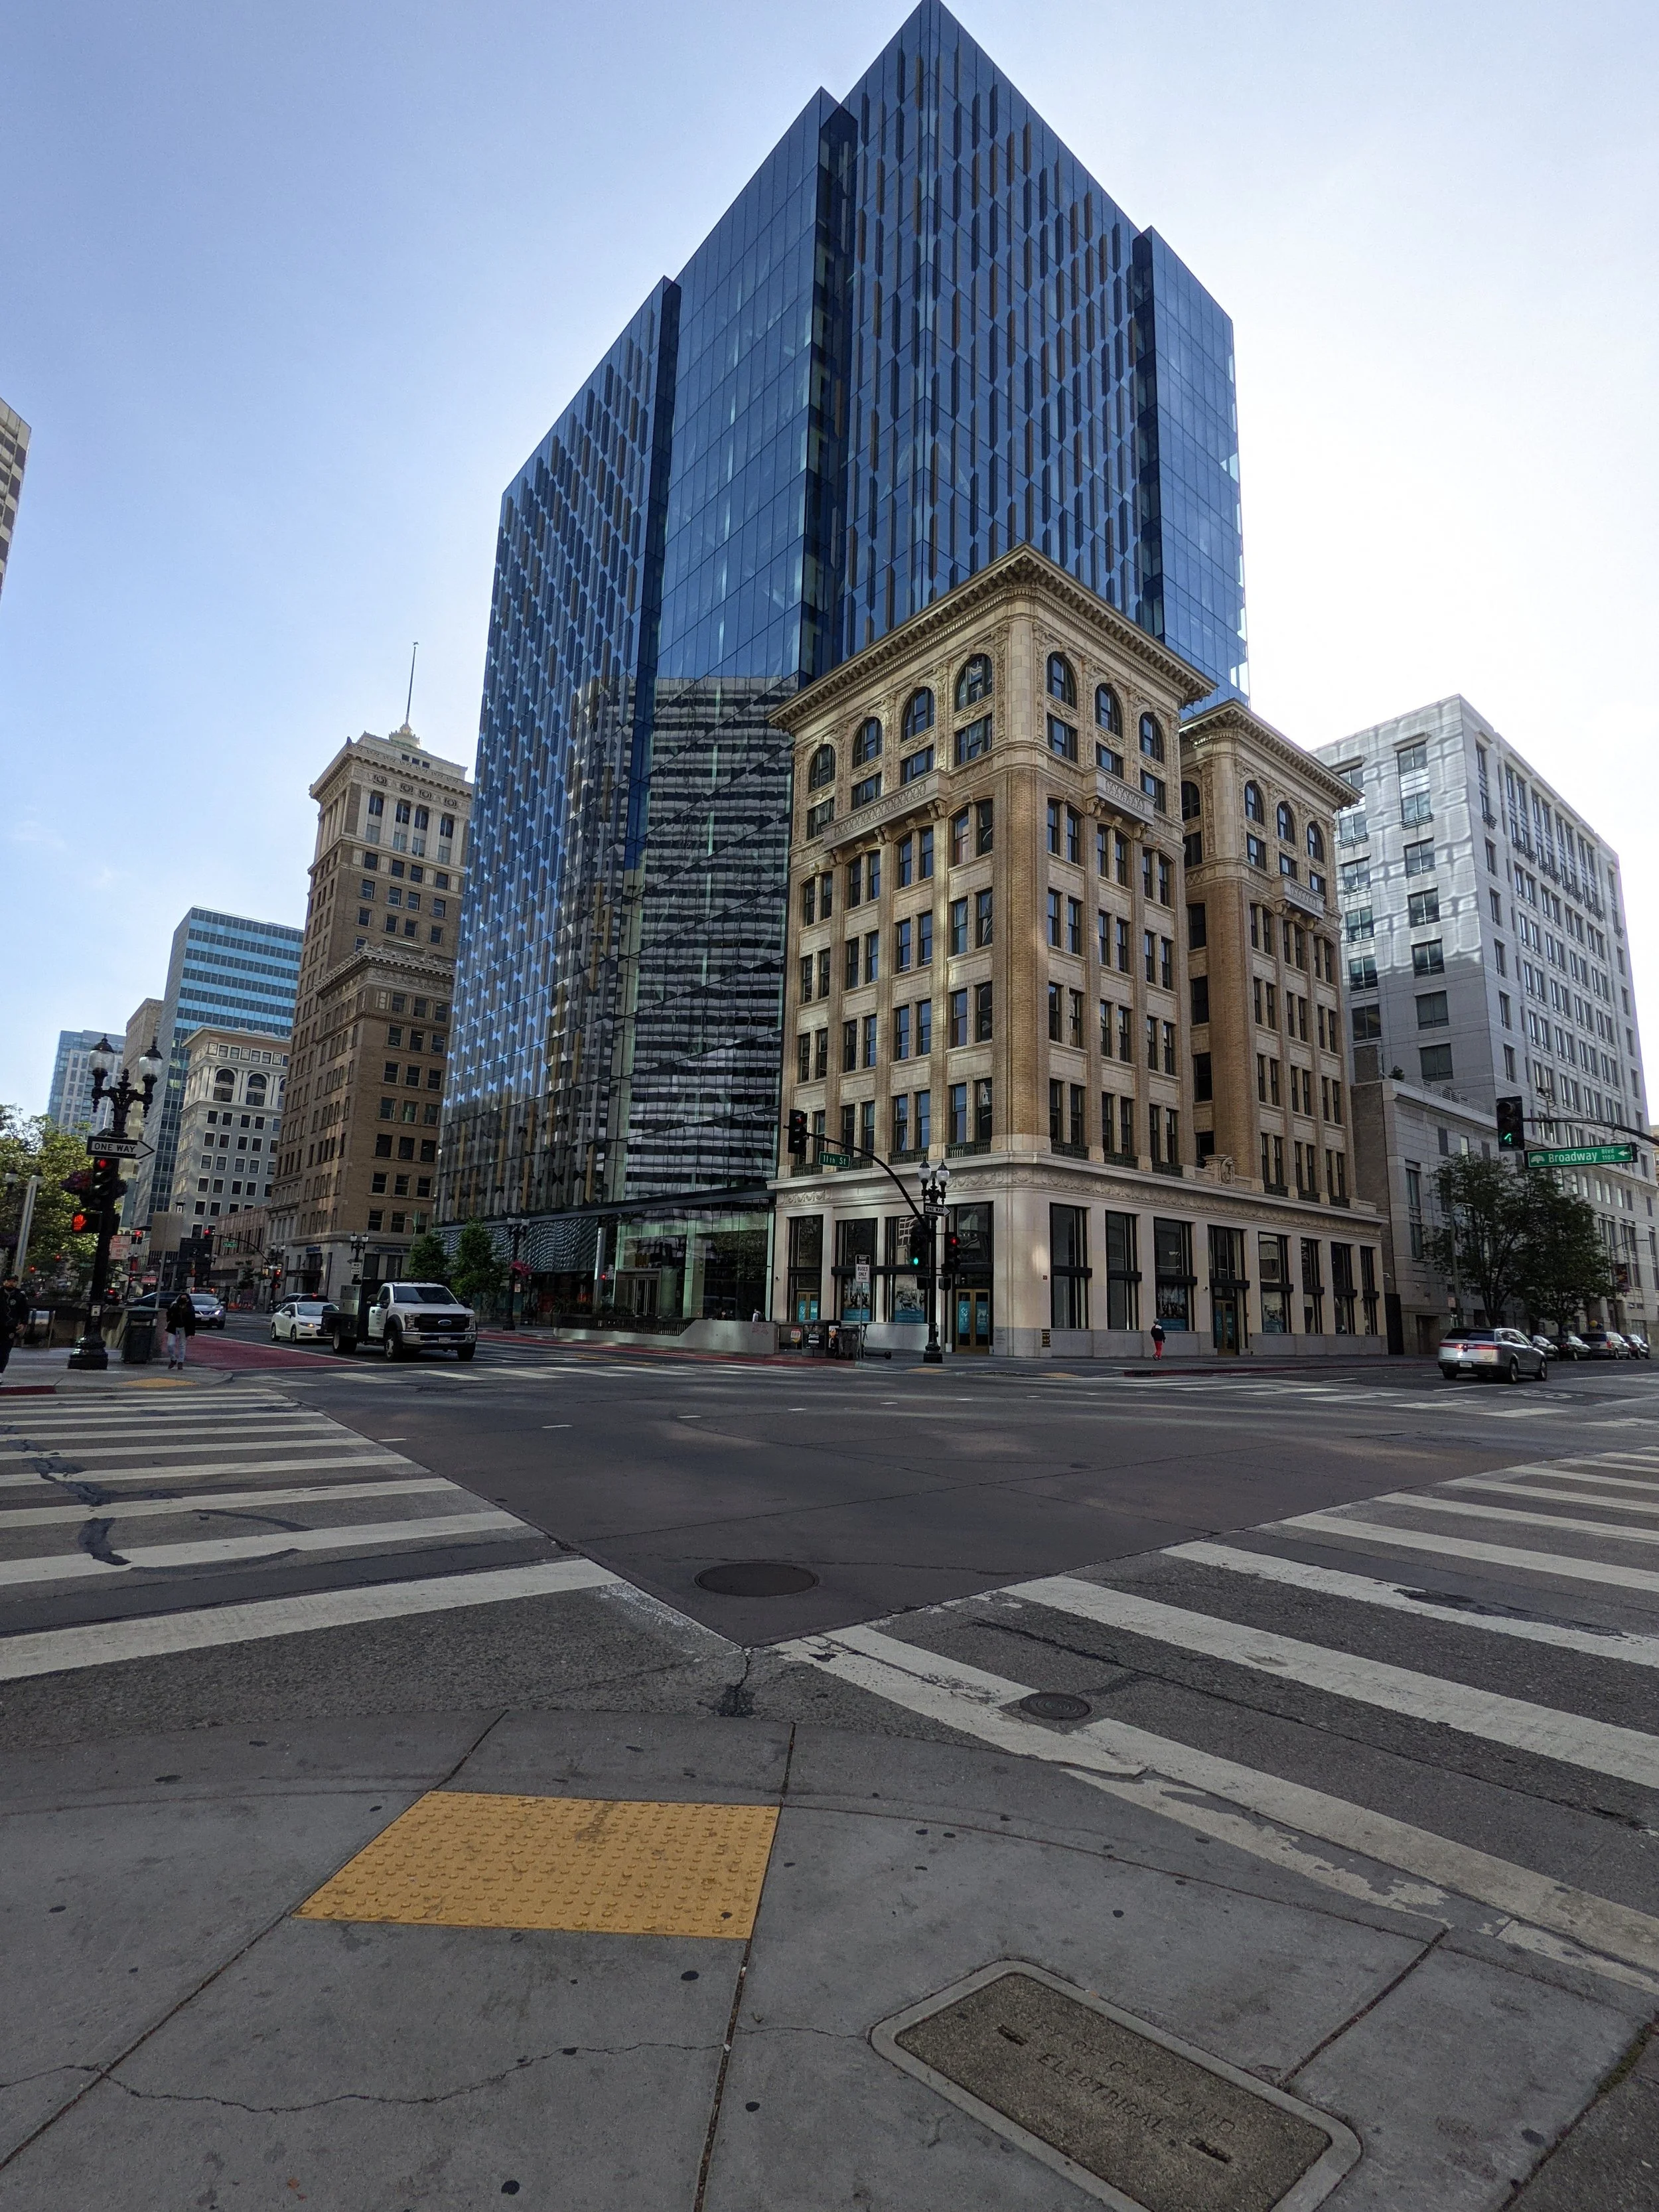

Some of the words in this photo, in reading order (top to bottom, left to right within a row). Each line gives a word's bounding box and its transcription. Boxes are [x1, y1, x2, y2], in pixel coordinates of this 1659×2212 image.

[823, 1155, 835, 1163] 11th
[839, 1157, 846, 1165] St
[1548, 1151, 1597, 1163] Broadway
[1037, 2052, 1166, 2133] ELECTRICAL
